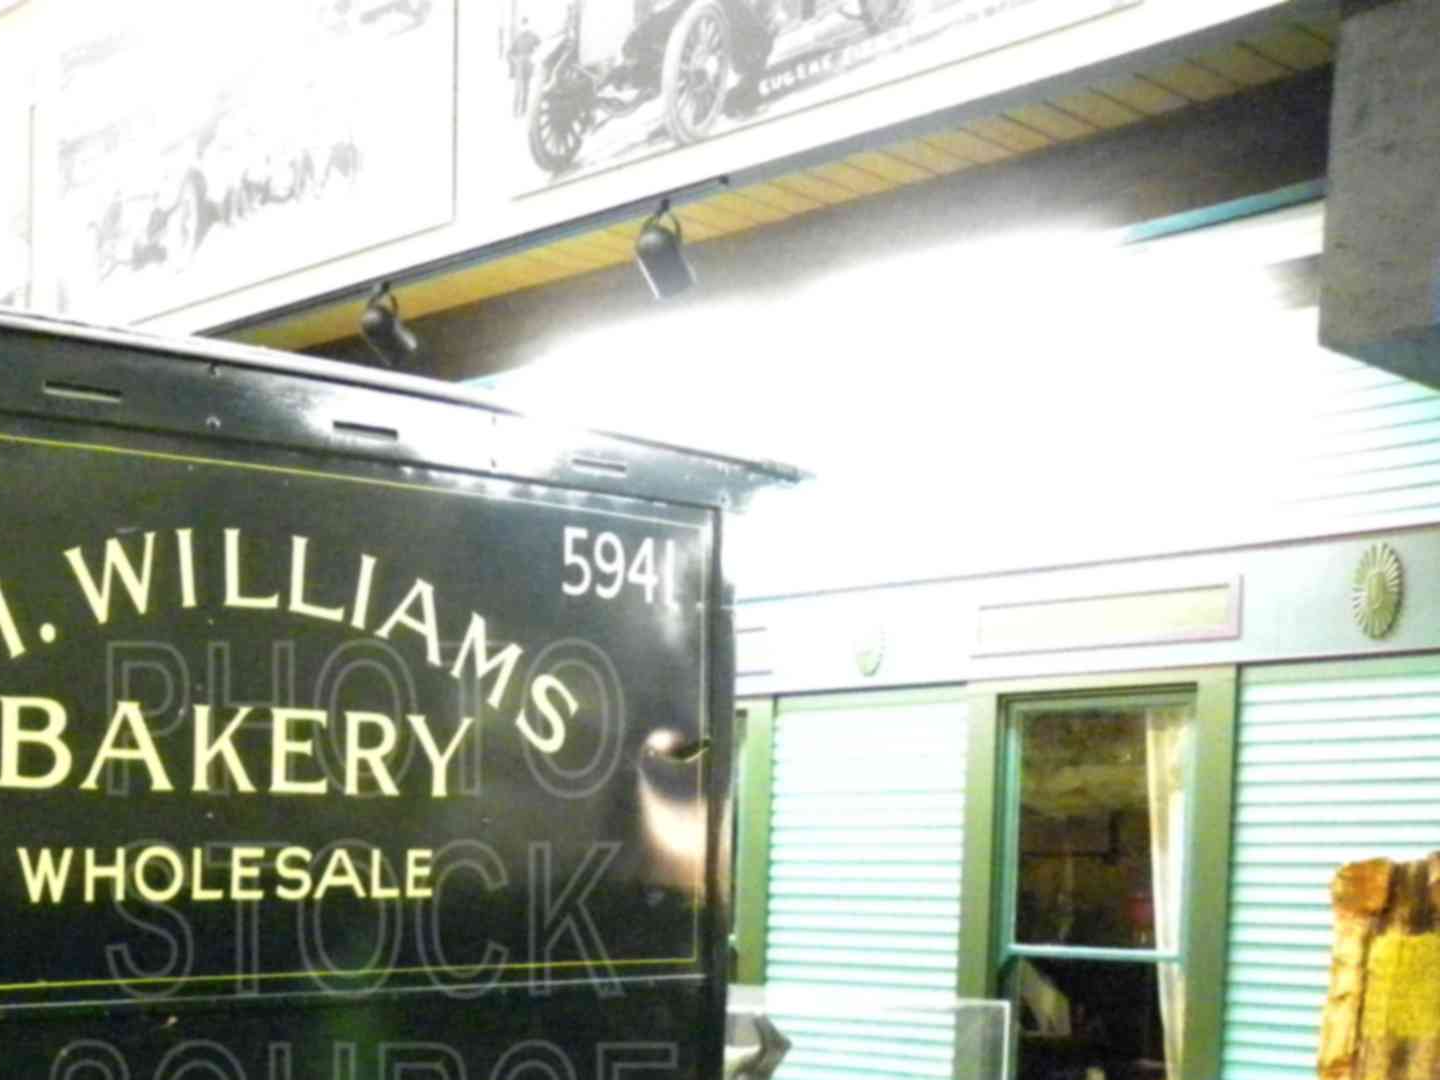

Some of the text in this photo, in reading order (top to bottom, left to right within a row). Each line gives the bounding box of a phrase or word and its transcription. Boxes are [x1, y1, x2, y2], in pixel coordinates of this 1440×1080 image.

[561, 525, 677, 612] 5941
[62, 527, 581, 755] WILLIAMS
[16, 844, 434, 903] WHOLESALE
